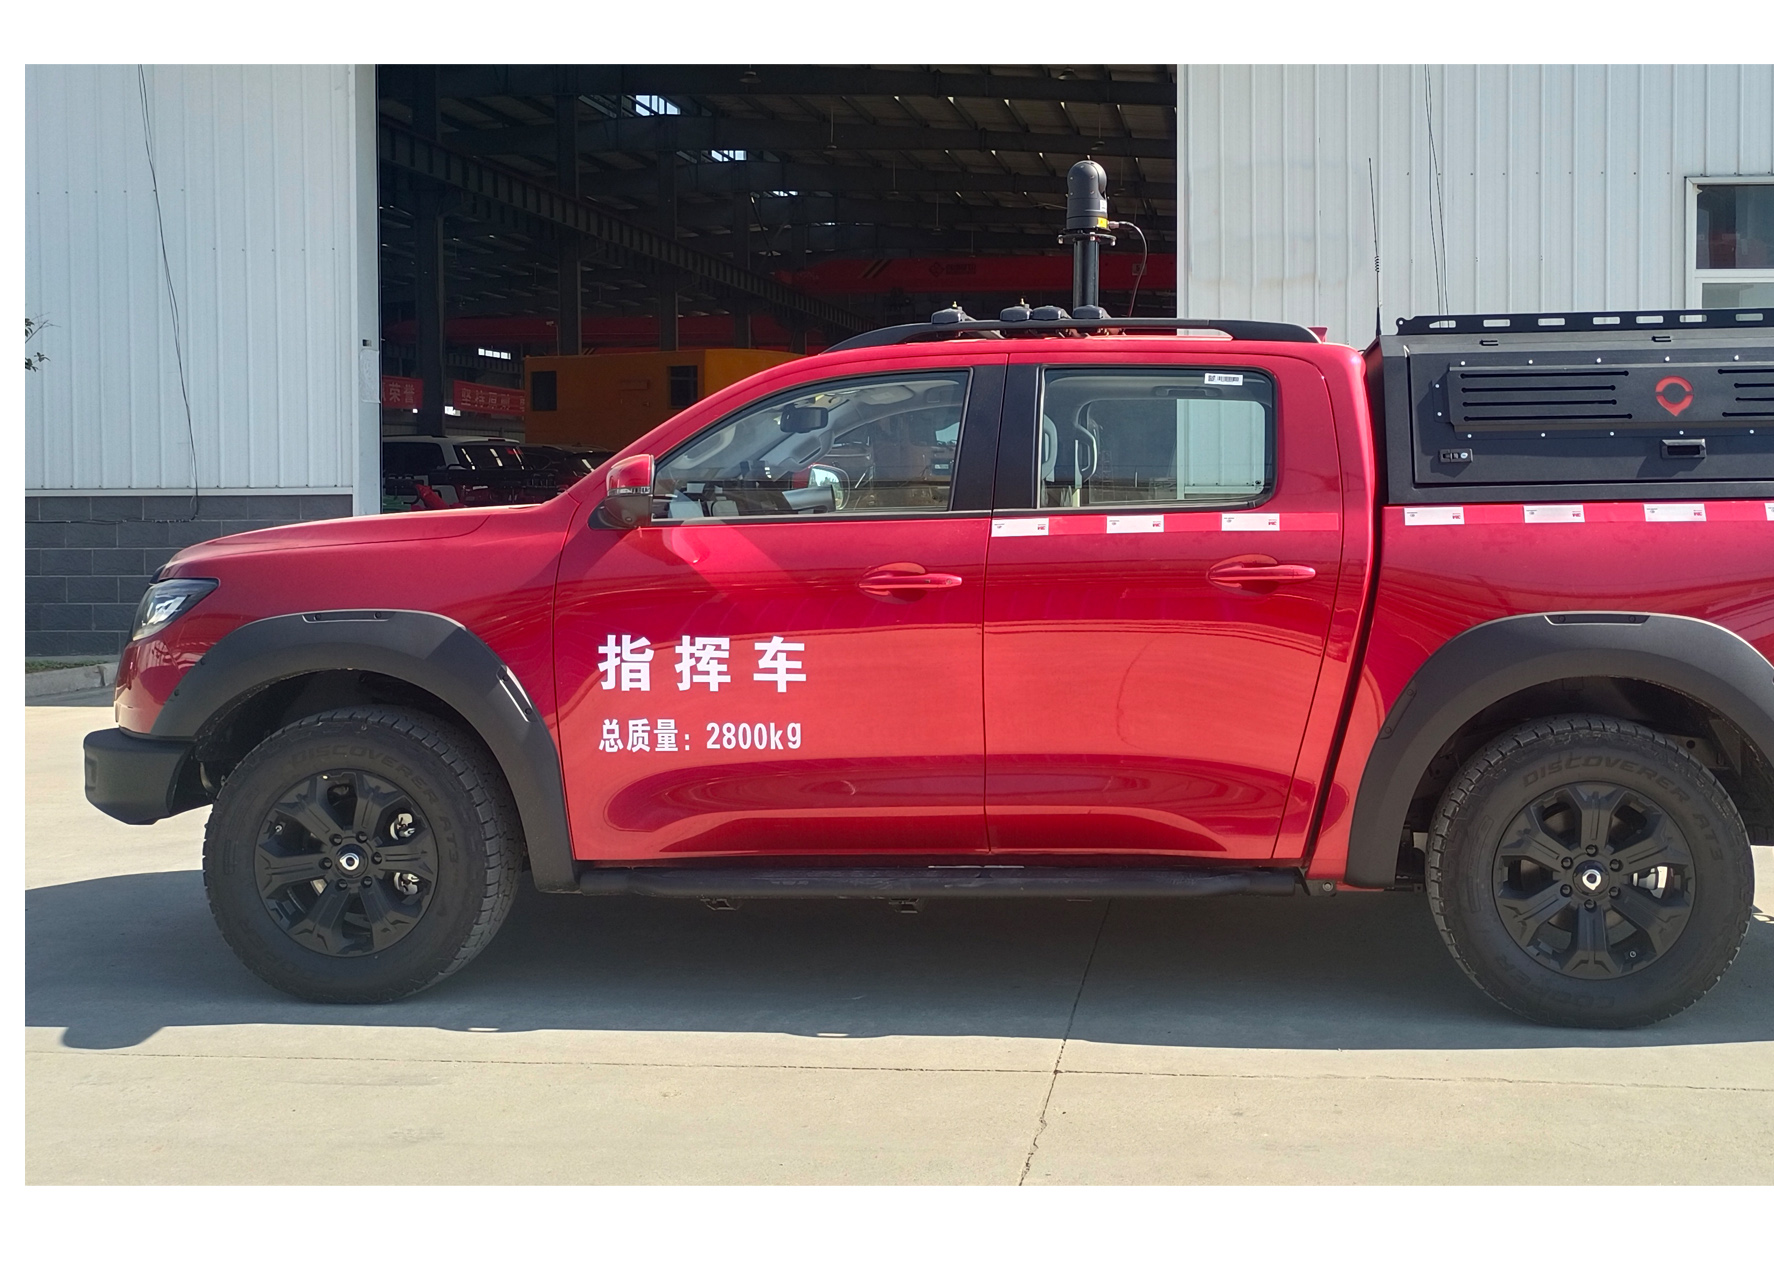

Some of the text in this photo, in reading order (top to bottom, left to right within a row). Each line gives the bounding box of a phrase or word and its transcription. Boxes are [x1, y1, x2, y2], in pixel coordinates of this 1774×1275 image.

[382, 382, 415, 404] 荣誉
[598, 634, 807, 693] 指挥车
[1523, 755, 1691, 802] DISCOVERER
